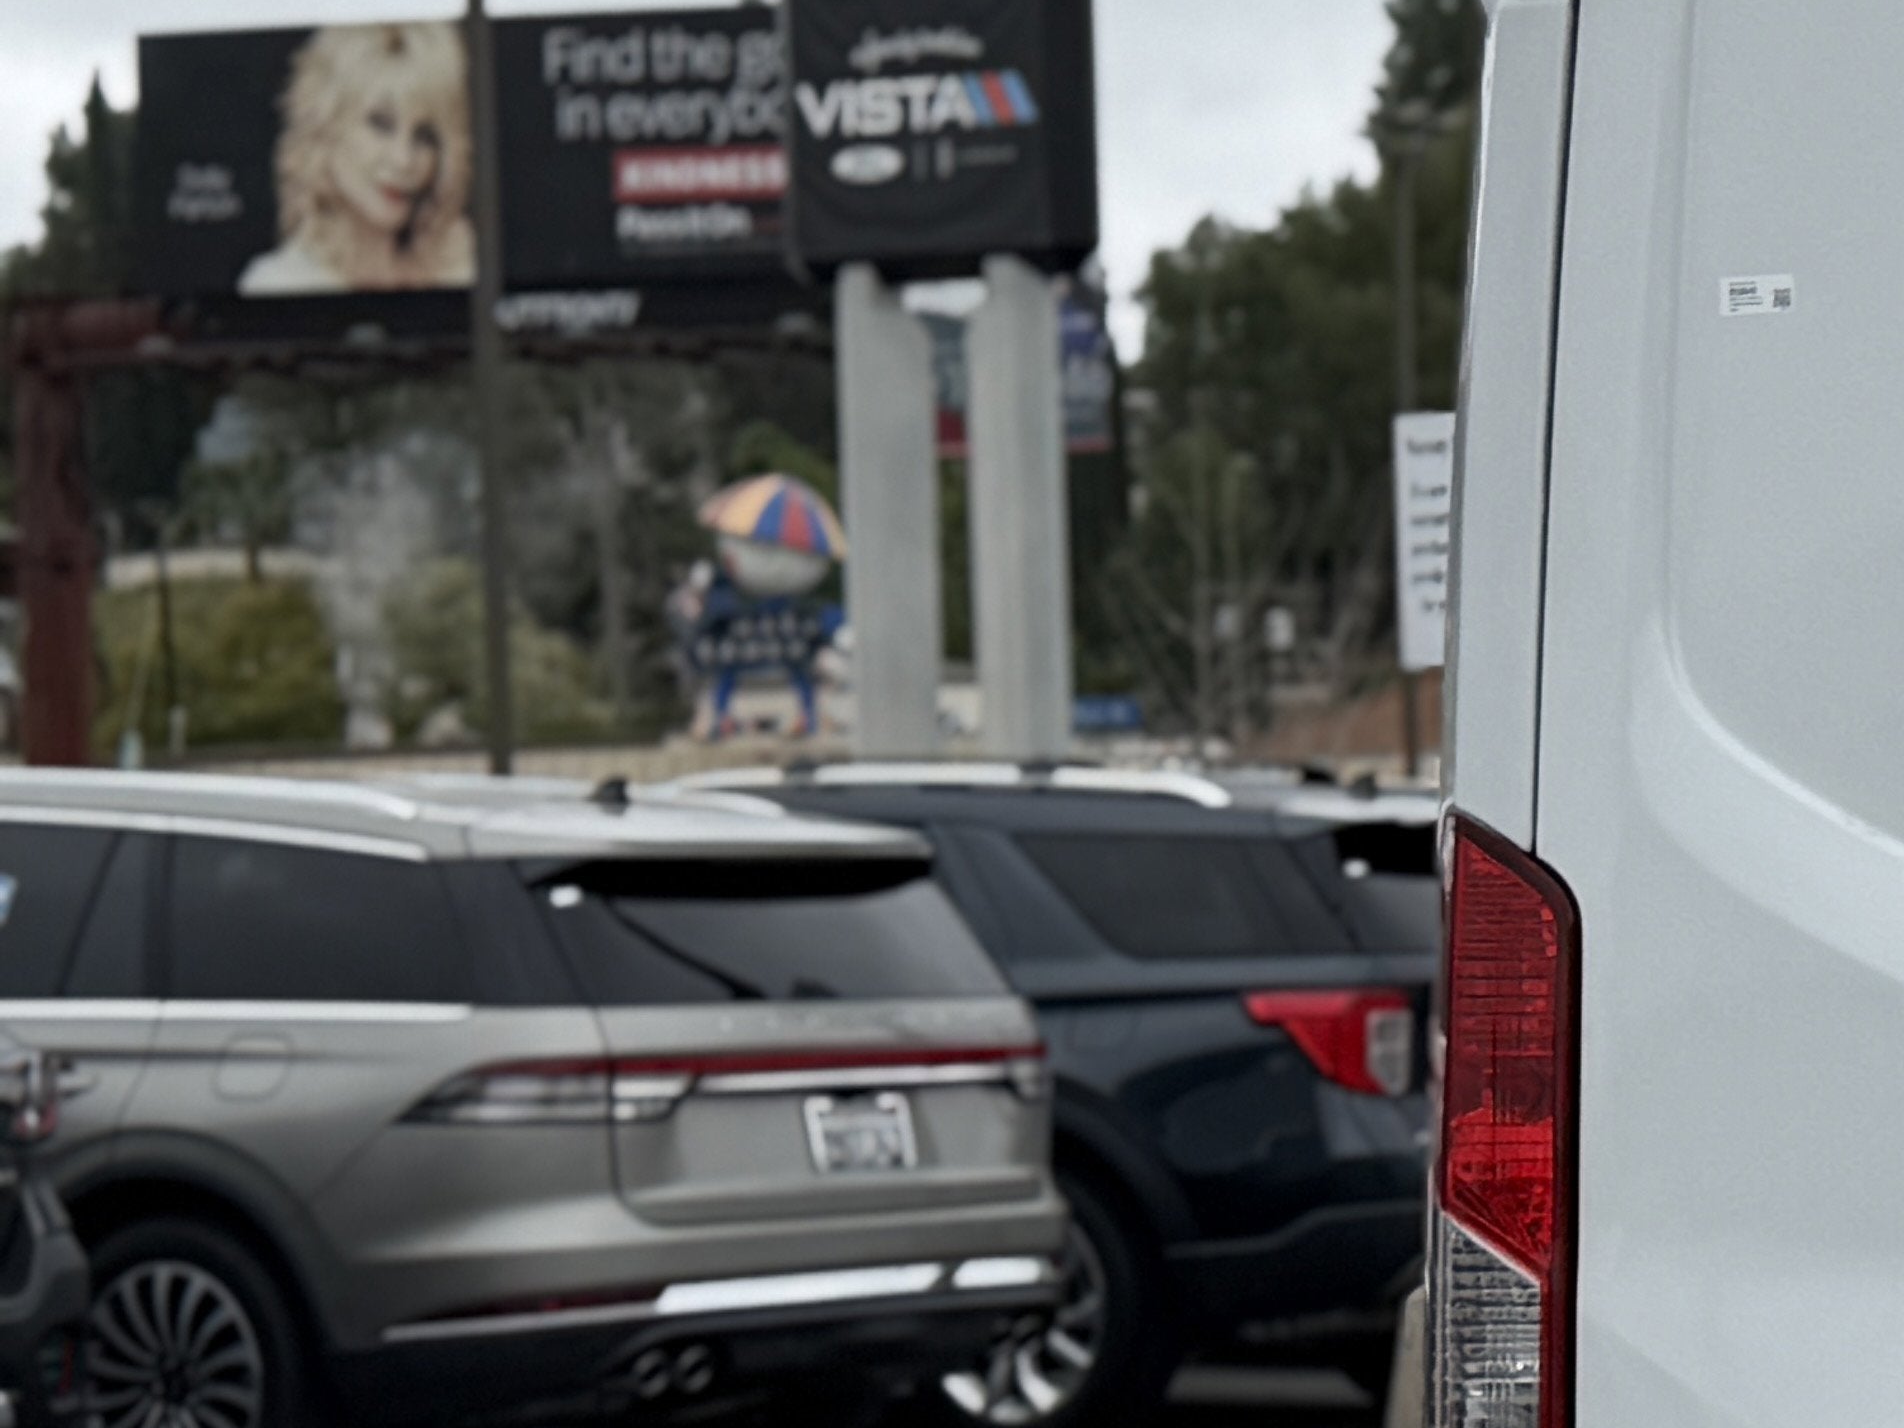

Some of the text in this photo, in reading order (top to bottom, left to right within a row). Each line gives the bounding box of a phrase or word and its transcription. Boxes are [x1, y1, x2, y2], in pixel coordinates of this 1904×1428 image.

[543, 28, 644, 84] Find
[651, 28, 732, 80] the
[737, 31, 787, 97] go
[555, 85, 600, 139] in
[796, 76, 978, 137] VISTA
